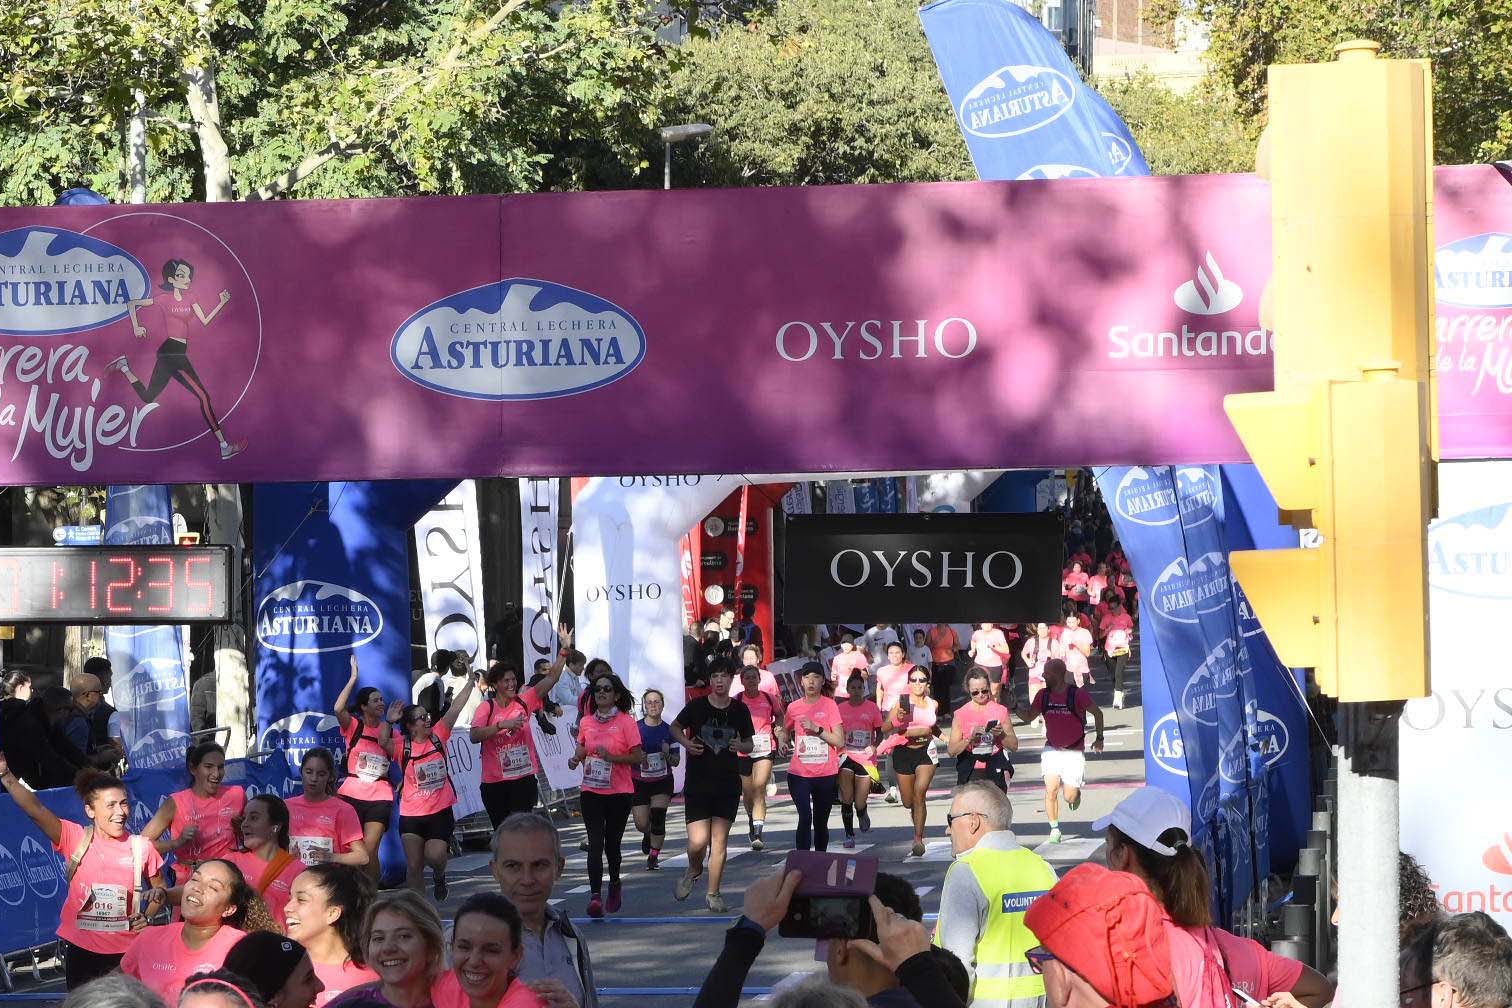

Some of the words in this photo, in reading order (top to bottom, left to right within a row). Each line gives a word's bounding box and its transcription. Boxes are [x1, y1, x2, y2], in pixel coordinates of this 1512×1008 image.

[53, 262, 125, 274] LECHERA
[449, 320, 529, 334] CENTRAL
[536, 318, 618, 331] LECHERA
[775, 317, 977, 362] OYSHO
[411, 325, 626, 370] ASTURIANA
[1108, 325, 1276, 359] Santand
[11, 380, 160, 471] Mujer
[830, 549, 1023, 589] OYSHO
[586, 583, 662, 601] OYSHO
[261, 609, 375, 637] ASTURIANA
[273, 605, 316, 614] CENTRAL
[319, 604, 370, 613] LECHERA
[1403, 688, 1512, 731] OYS
[94, 901, 113, 911] 016
[1003, 895, 1038, 908] VOLUNT
